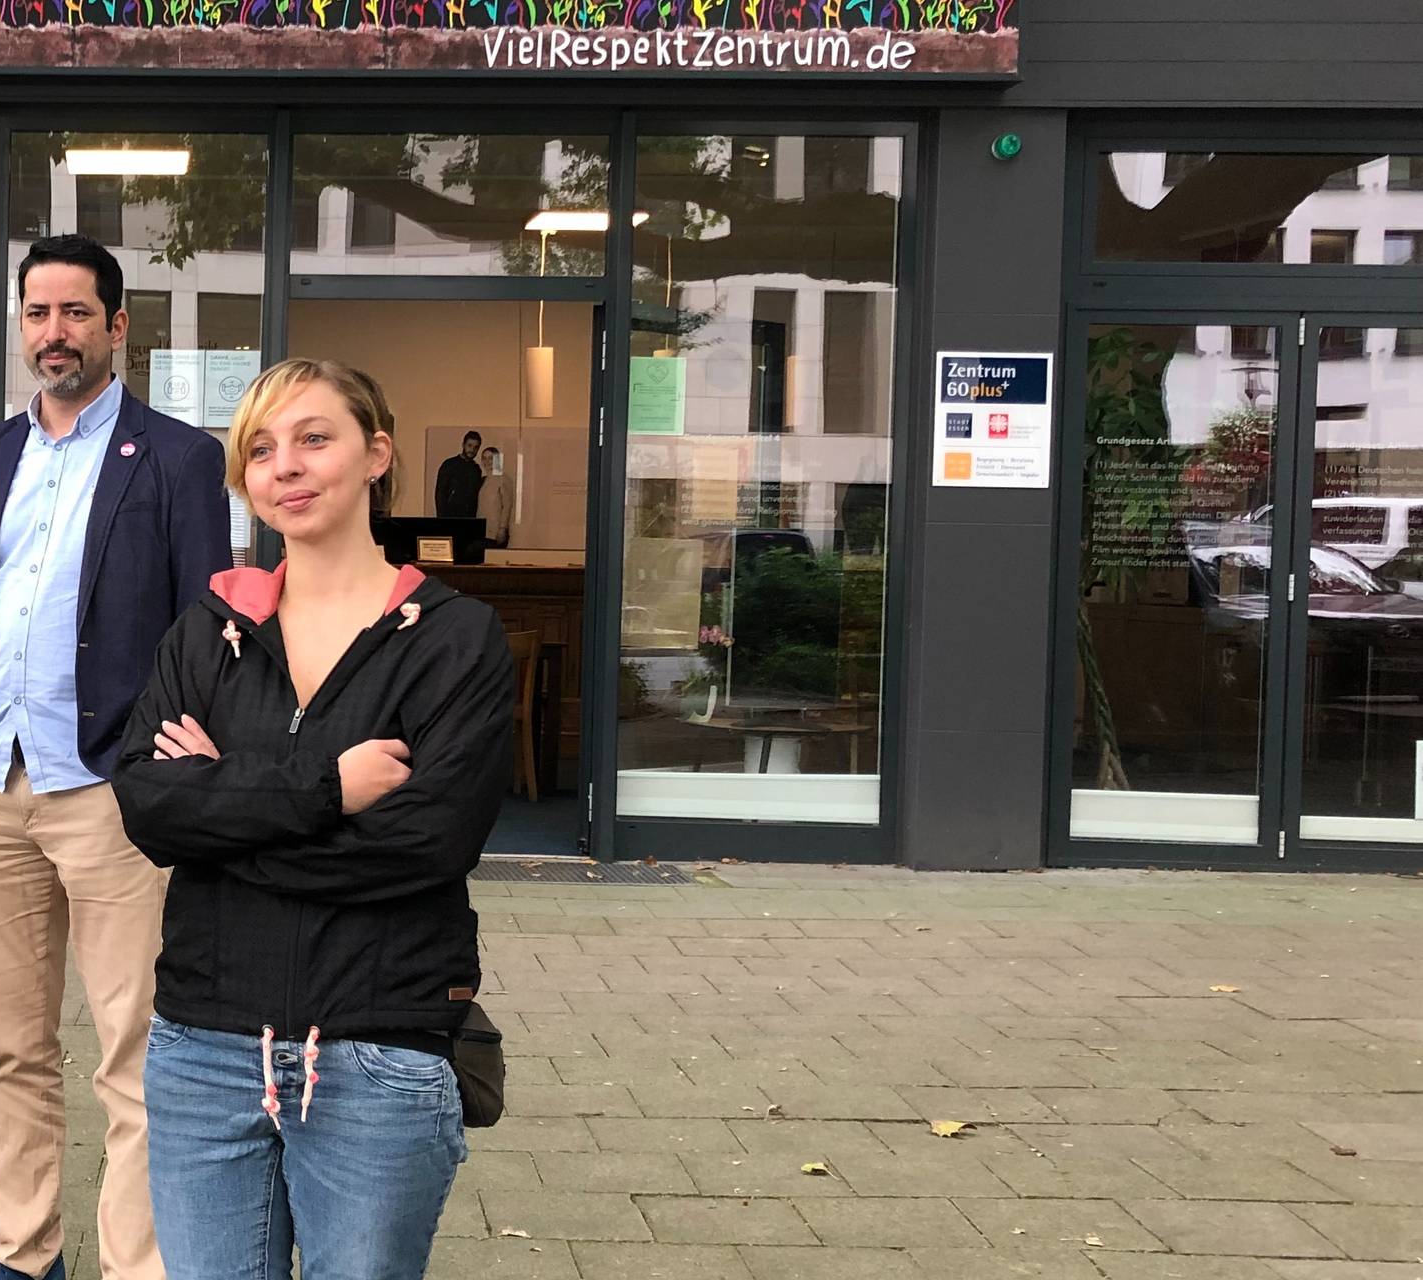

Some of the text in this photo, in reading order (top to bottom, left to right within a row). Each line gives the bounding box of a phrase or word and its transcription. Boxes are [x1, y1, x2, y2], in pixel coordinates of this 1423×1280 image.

[484, 29, 916, 70] VielRespektZentrum.de
[947, 363, 1016, 378] Zentrum
[1096, 436, 1154, 446] Grundgesetz
[1338, 465, 1356, 474] Alle
[1130, 473, 1157, 482] Schrift
[1159, 473, 1176, 482] und
[1170, 486, 1188, 495] und
[1322, 513, 1384, 523] zuwiderlaufen
[1091, 545, 1111, 554] Film
[1112, 546, 1145, 555] werden
[1091, 557, 1121, 566] Zensur
[1122, 558, 1147, 567] findet
[1148, 559, 1170, 568] nicht
